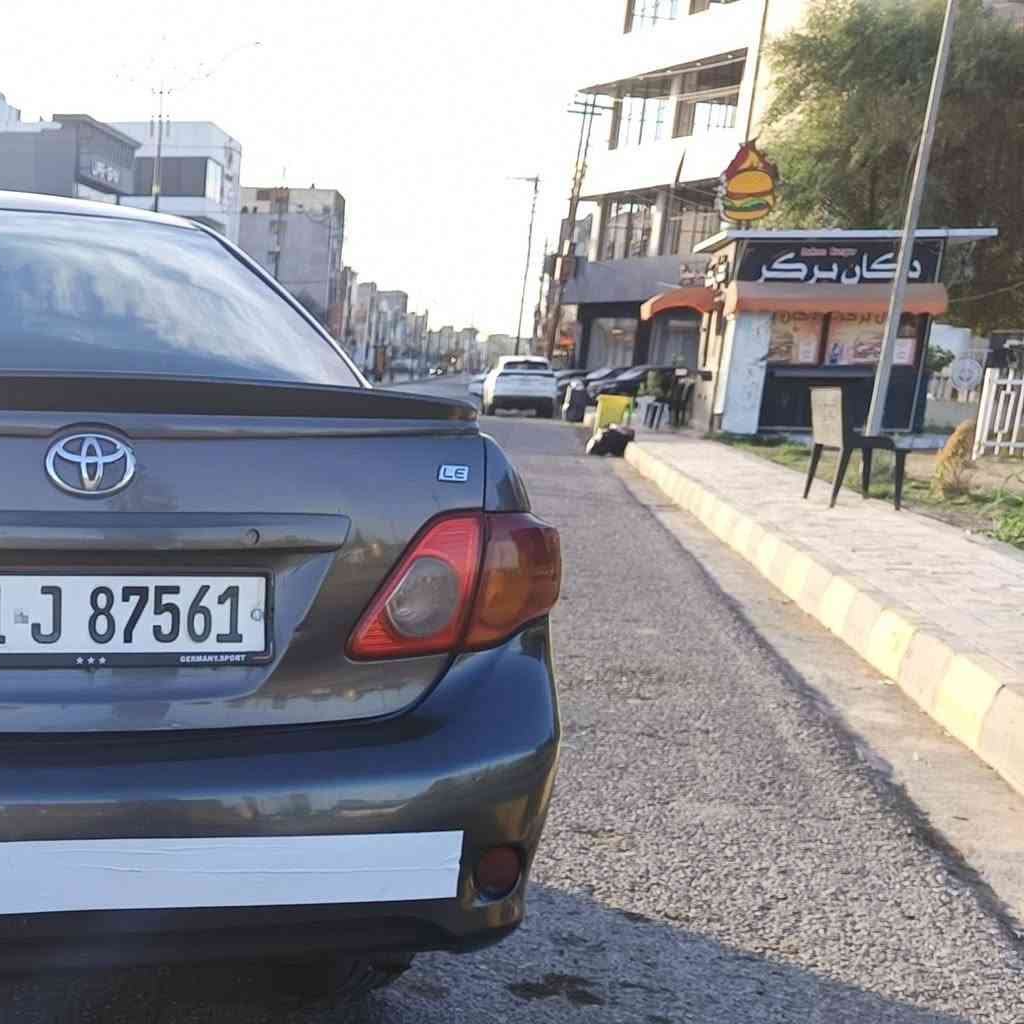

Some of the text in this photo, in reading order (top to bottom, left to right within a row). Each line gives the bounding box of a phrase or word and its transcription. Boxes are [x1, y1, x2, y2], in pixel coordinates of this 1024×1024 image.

[443, 467, 465, 479] LE
[31, 586, 62, 644] J
[87, 585, 243, 645] 87561
